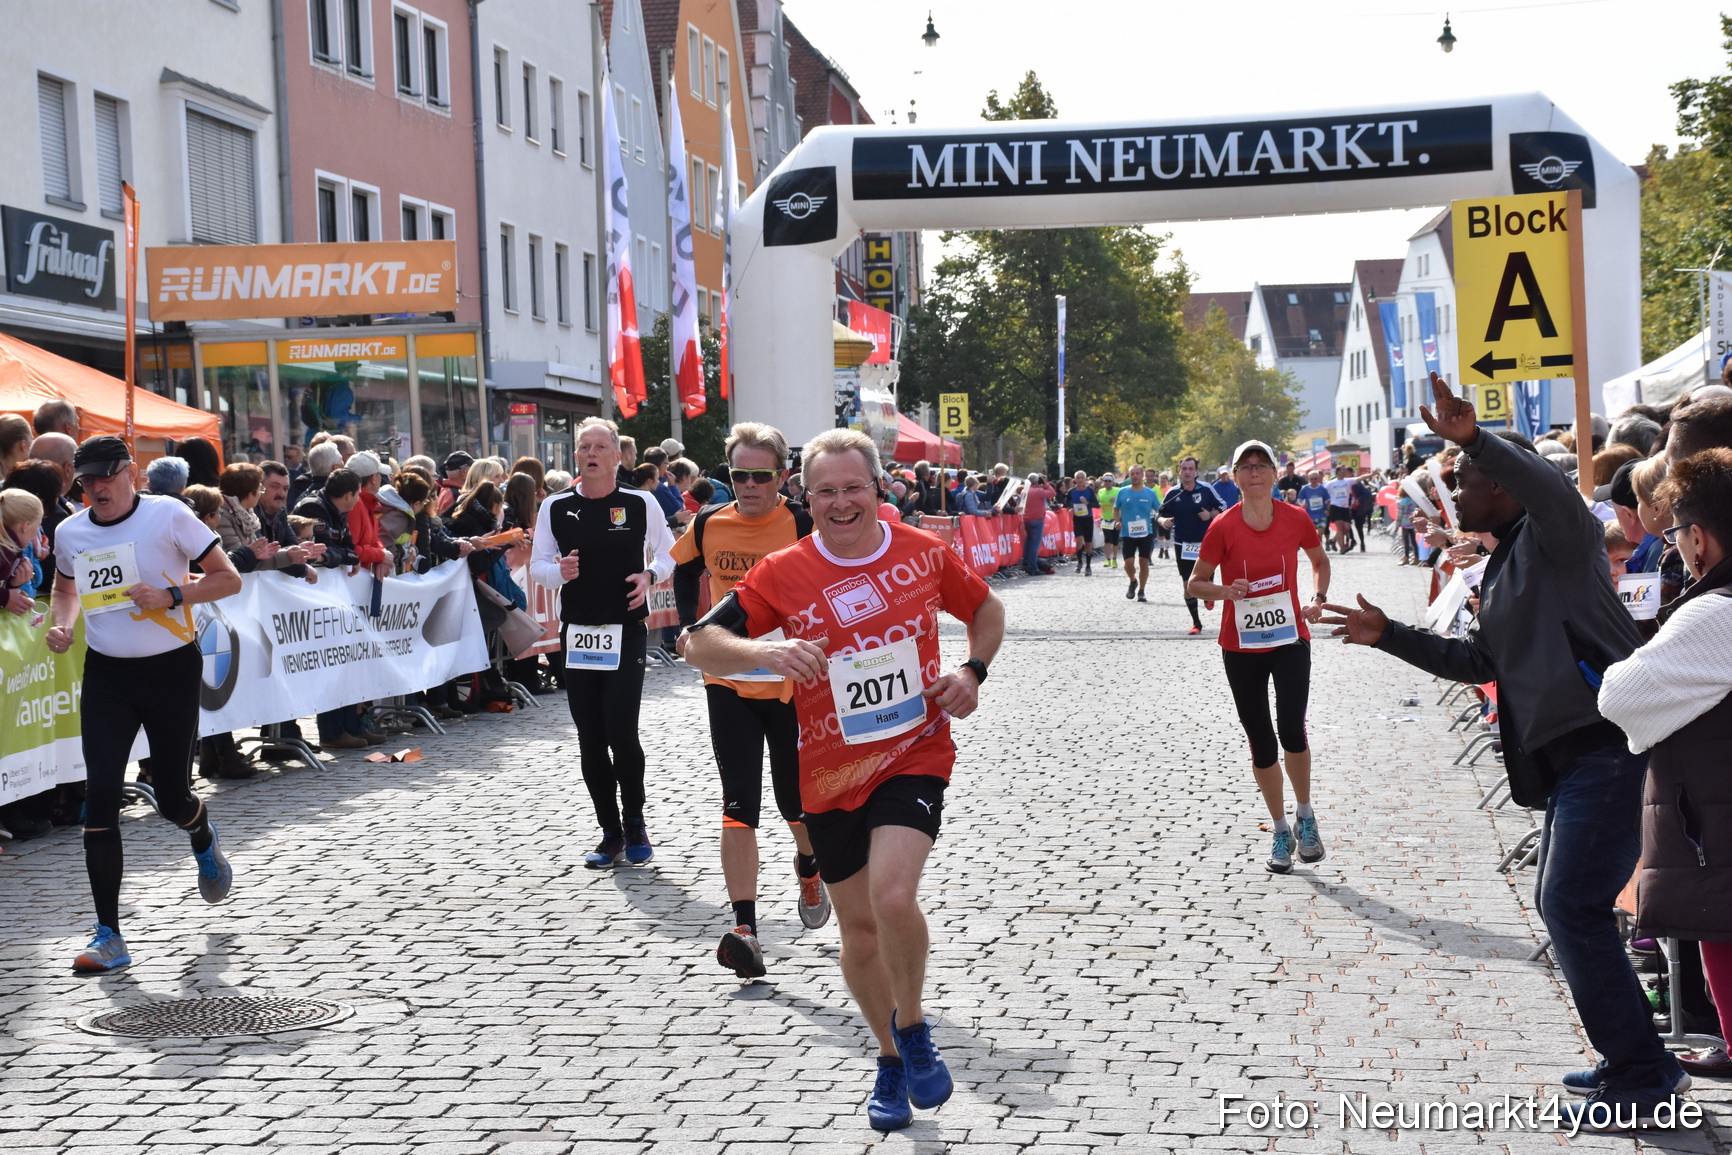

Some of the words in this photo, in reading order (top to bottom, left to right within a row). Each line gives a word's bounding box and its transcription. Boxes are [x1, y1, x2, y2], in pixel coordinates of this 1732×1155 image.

[907, 140, 1048, 188] MINI
[1066, 119, 1431, 184] NEUMARKT.
[1541, 166, 1563, 174] MINI
[790, 202, 809, 210] MINI
[1467, 200, 1568, 239] Block
[1484, 251, 1559, 343] A
[289, 342, 396, 359] RUNMARKT.DE
[943, 395, 965, 405] Block
[1485, 389, 1501, 411] B
[947, 406, 962, 427] B
[1135, 452, 1144, 464] C
[88, 565, 123, 589] 229
[1257, 580, 1274, 588] DEHN
[102, 593, 117, 602] Uwe
[827, 577, 868, 600] raumbox
[272, 609, 311, 646] BMW
[1244, 608, 1287, 630] 2408
[575, 632, 613, 651] 2013
[1261, 631, 1275, 640] Gabi
[281, 649, 322, 675] WENIGER
[321, 638, 371, 672] VERBRAUCH.
[582, 653, 604, 662] Thomas
[863, 652, 895, 668] BOCK
[846, 668, 909, 710] 2071
[875, 710, 900, 725] Hans
[811, 752, 886, 794] Team
